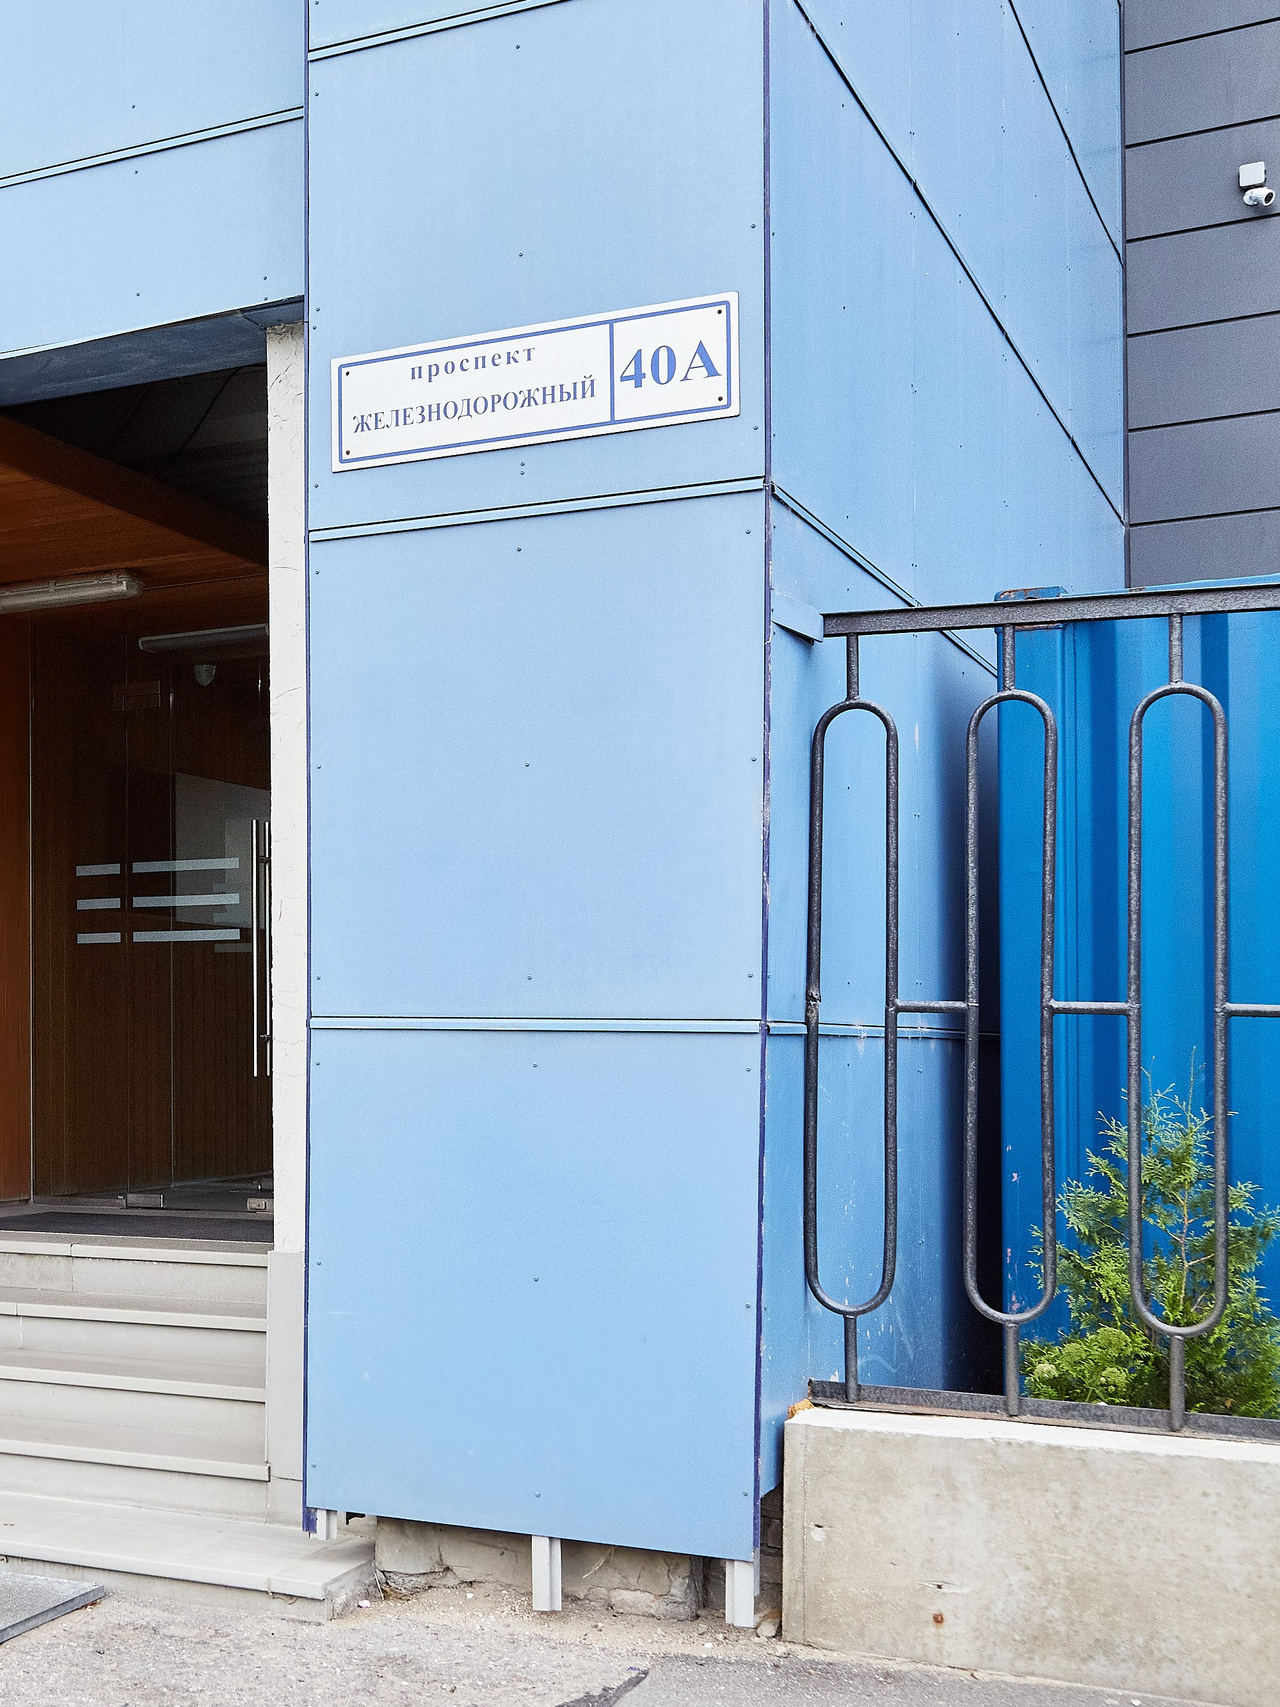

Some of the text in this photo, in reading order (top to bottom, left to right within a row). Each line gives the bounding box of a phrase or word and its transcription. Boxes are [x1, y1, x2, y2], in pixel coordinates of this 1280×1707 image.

[410, 347, 536, 382] проспект
[619, 340, 722, 388] 40А
[352, 374, 596, 433] ЖЕЛЕЗНОДОРОЖНЫЙ
